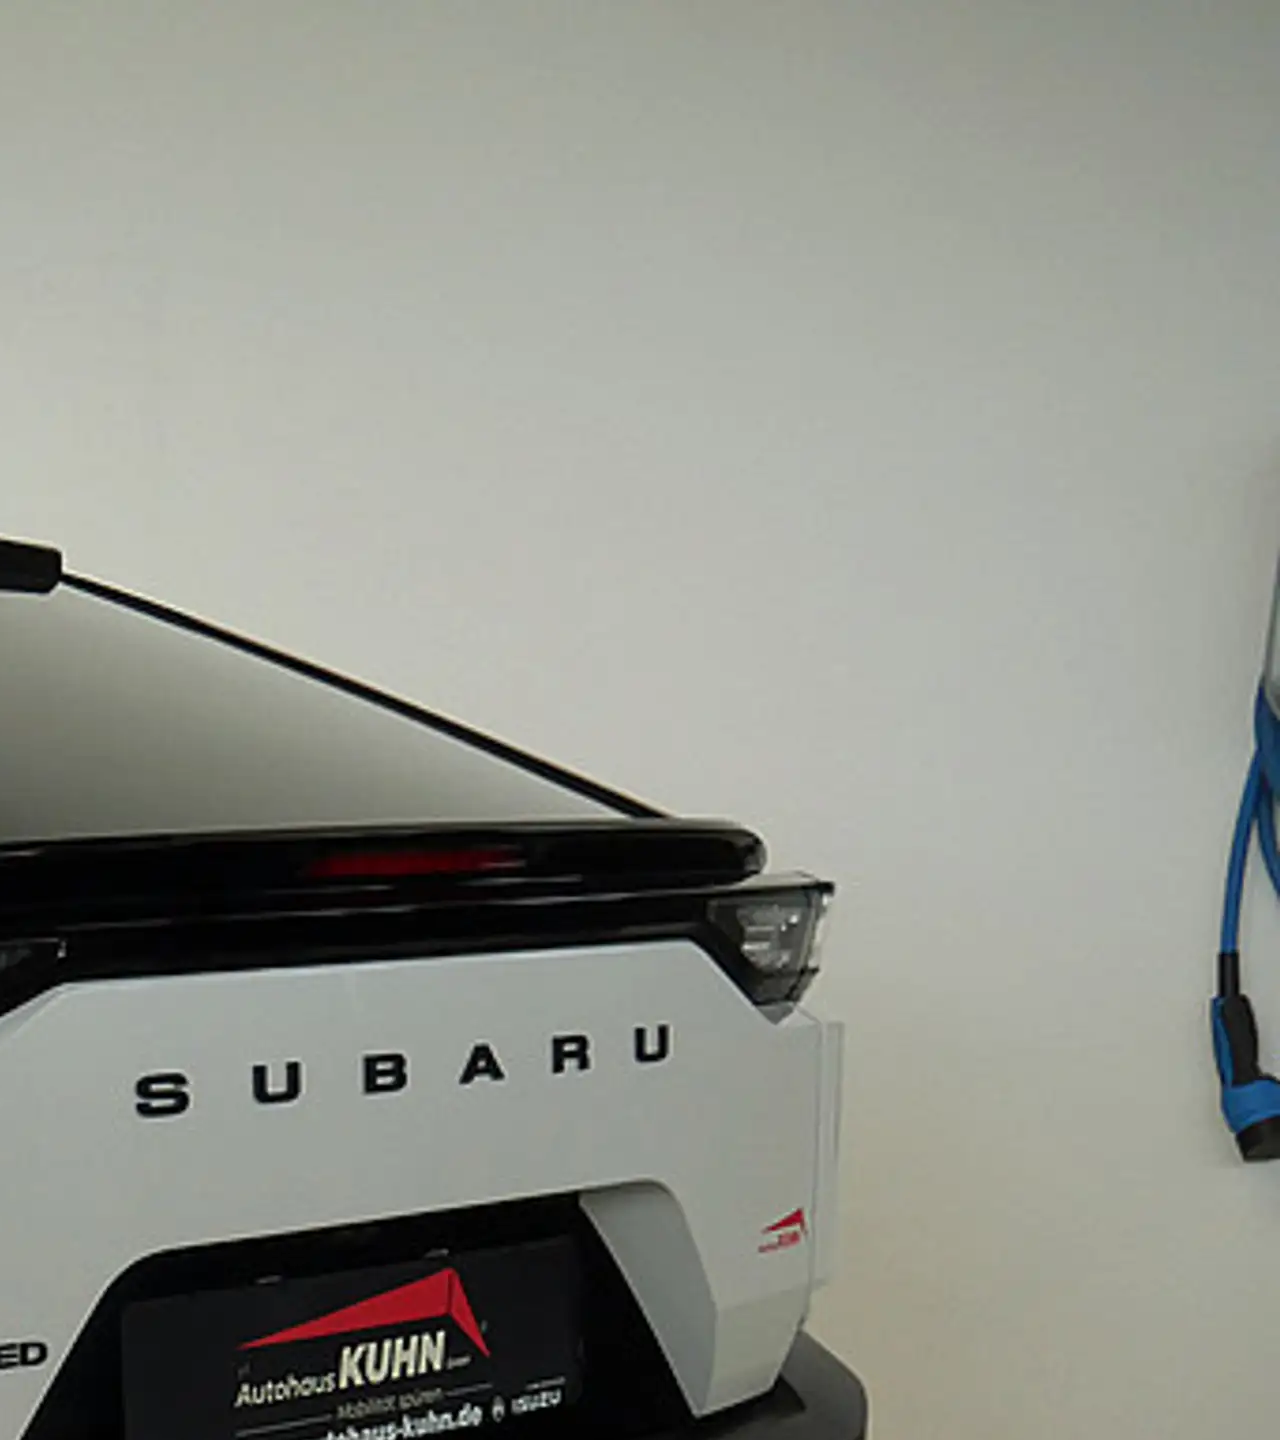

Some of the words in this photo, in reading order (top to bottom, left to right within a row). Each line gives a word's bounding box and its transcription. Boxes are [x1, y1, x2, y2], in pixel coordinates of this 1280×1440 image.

[135, 1024, 670, 1118] SUBARU
[234, 1372, 336, 1408] Autohaus
[338, 1329, 446, 1390] KUHN
